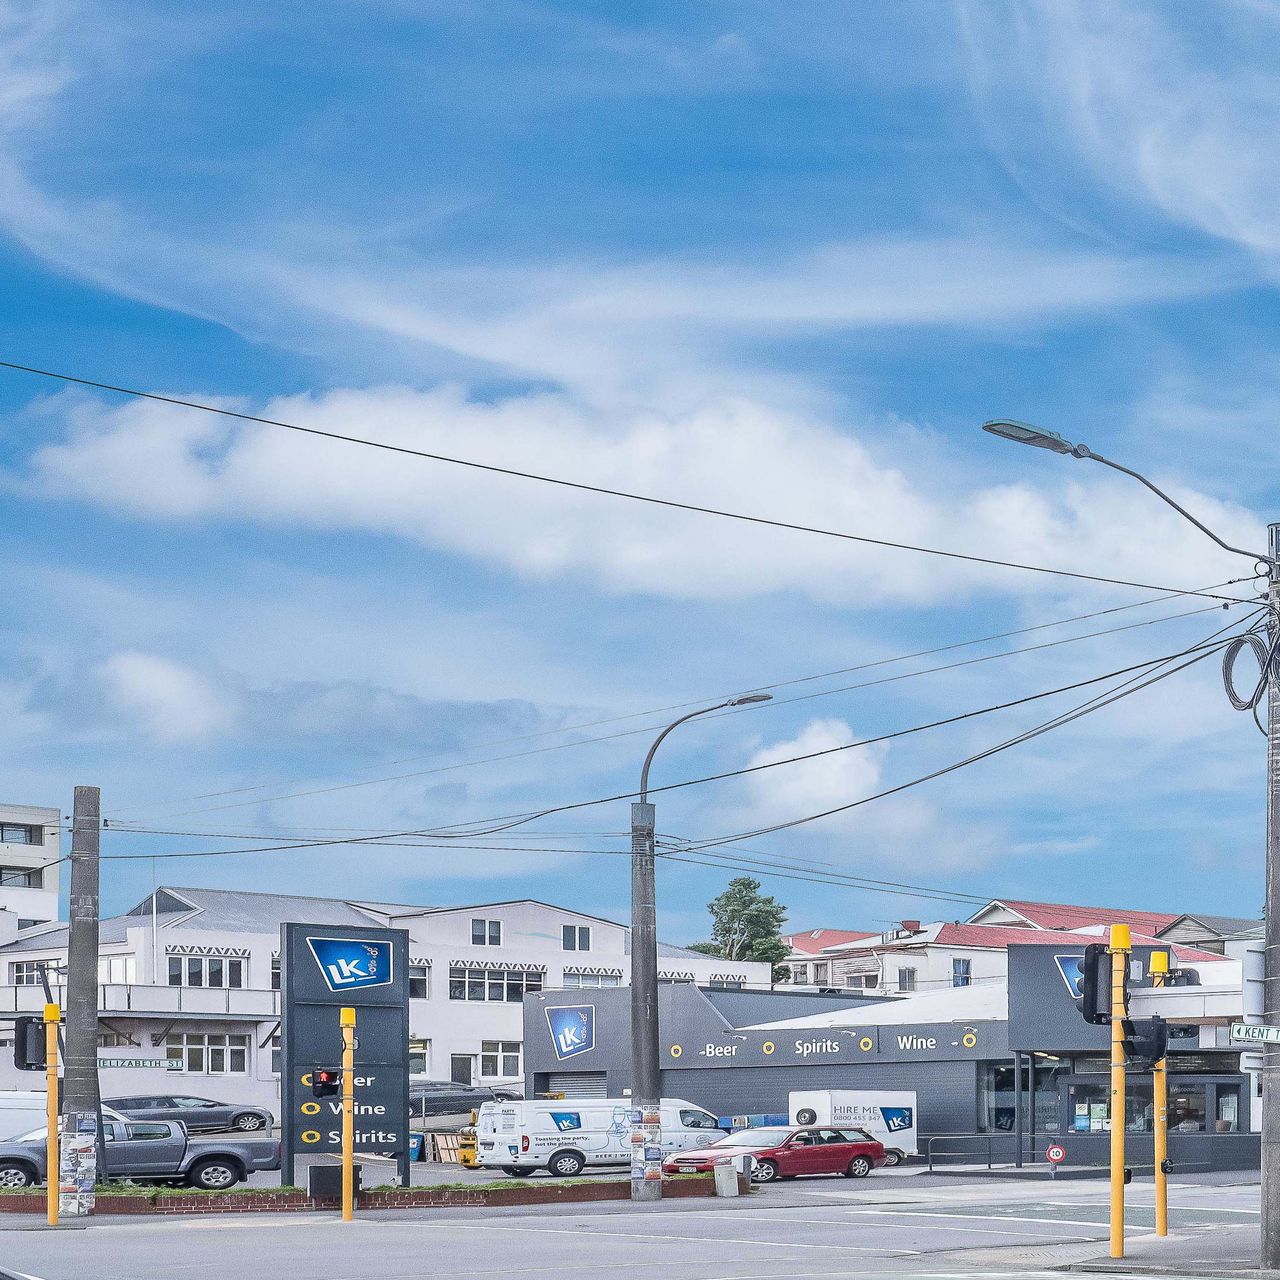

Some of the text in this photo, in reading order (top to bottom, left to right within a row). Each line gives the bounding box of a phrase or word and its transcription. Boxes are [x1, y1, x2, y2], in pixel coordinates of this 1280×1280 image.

[1244, 1026, 1271, 1039] KENT
[795, 1039, 840, 1057] Spirits
[897, 1035, 937, 1049] Wine
[705, 1043, 738, 1057] Beer
[833, 1106, 878, 1114] HIRE ME
[328, 1130, 397, 1144] Sirits
